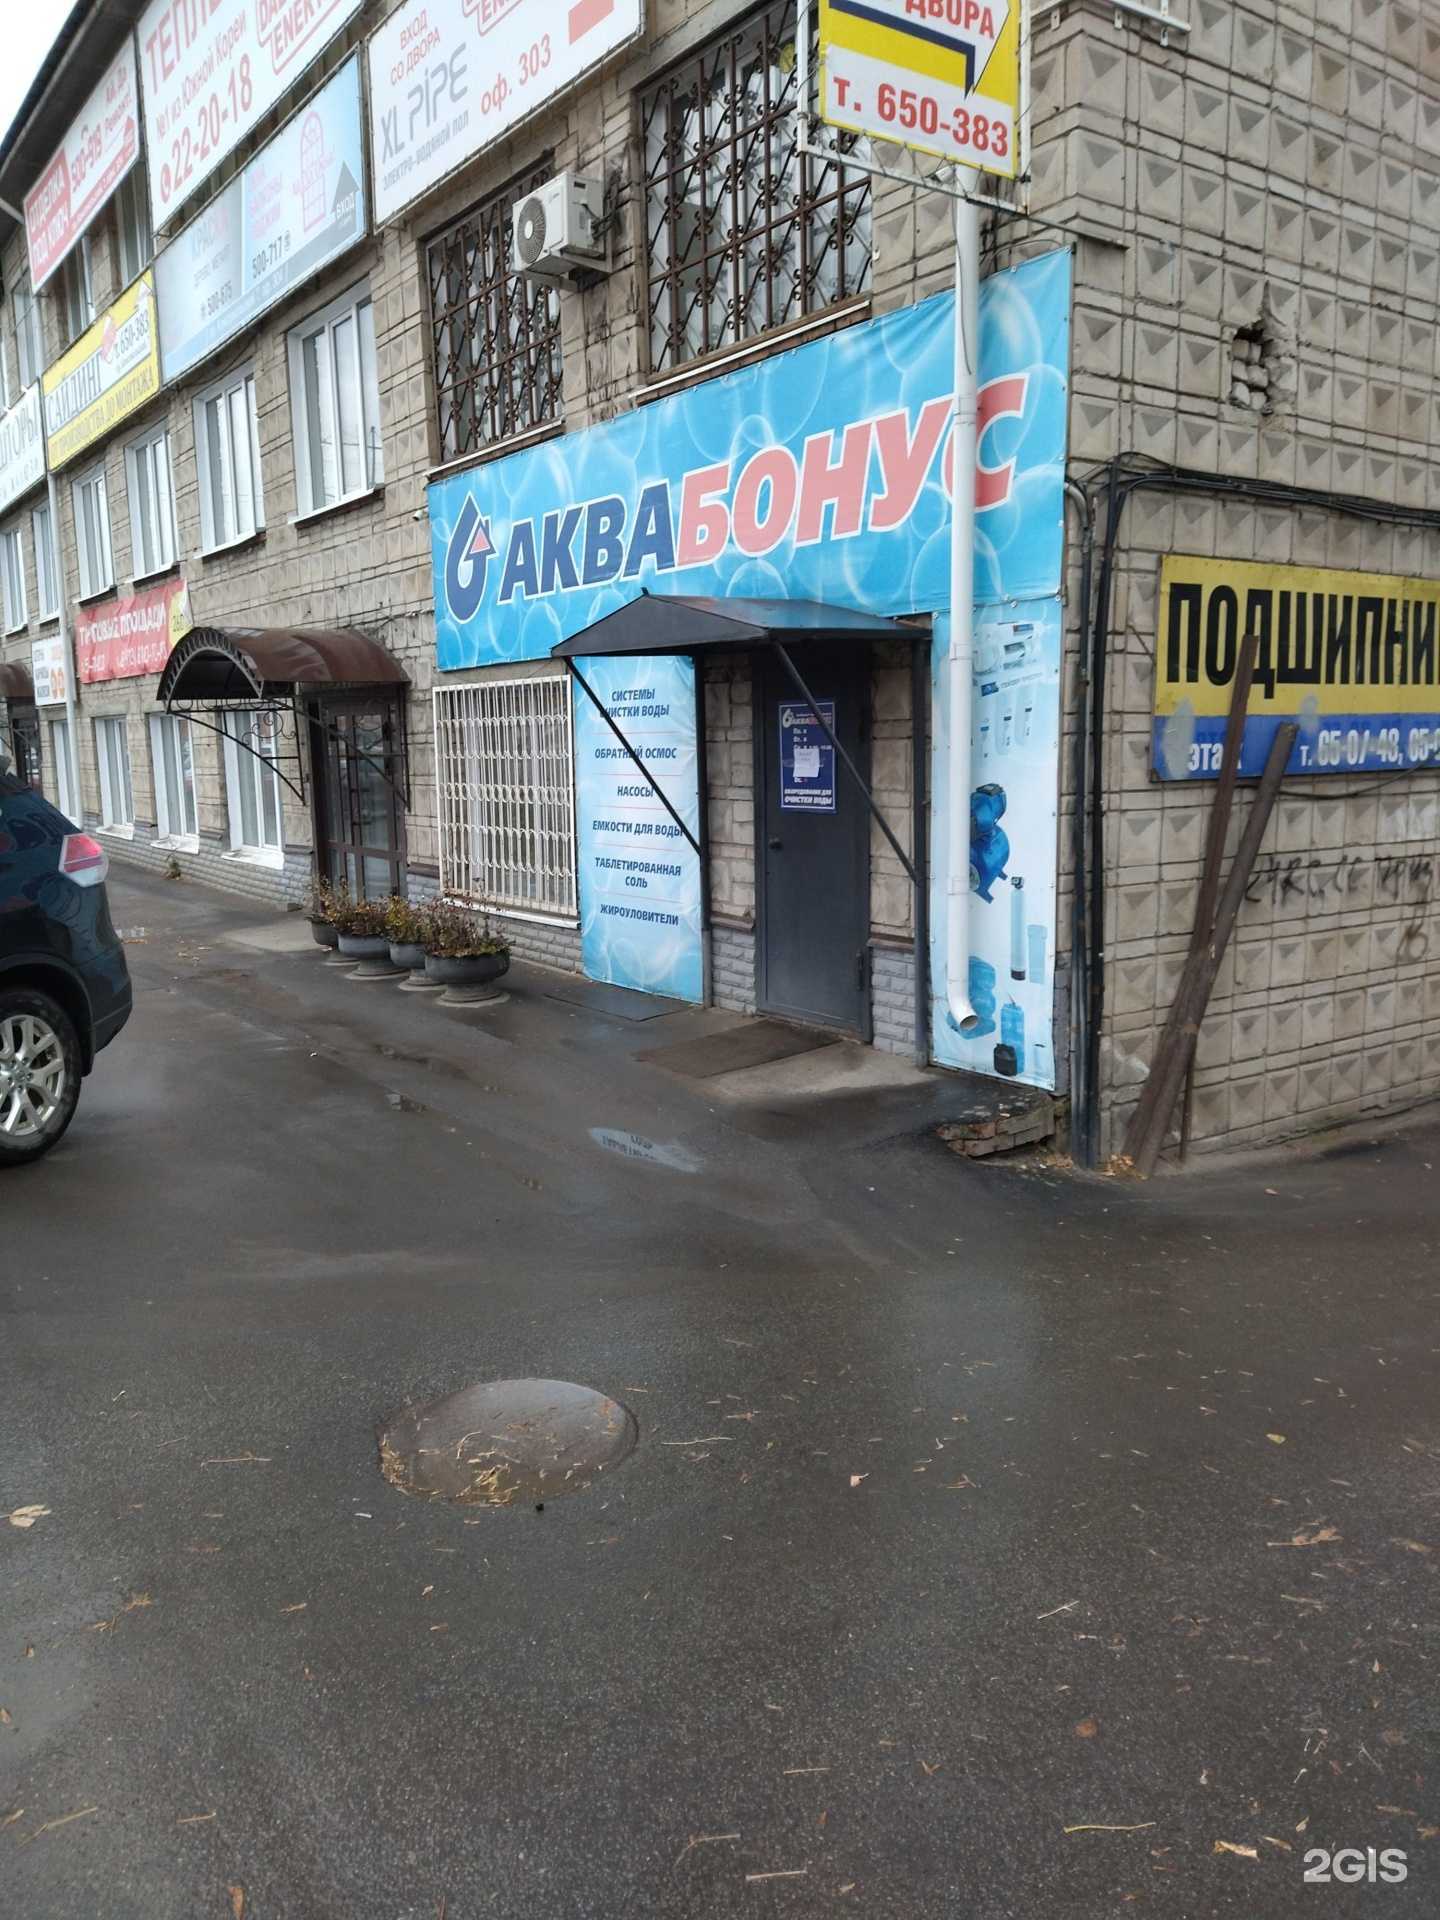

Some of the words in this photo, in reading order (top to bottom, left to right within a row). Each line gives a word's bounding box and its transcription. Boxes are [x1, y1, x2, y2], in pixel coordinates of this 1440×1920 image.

[400, 8, 428, 50] ВХОД
[146, 0, 222, 96] ТЕПЛ
[391, 61, 405, 86] СО
[406, 26, 440, 75] ДВОРА
[182, 46, 215, 109] Южной
[481, 72, 512, 115] оф.
[519, 32, 551, 86] 303
[172, 52, 252, 192] 22-20-18
[382, 105, 405, 165] XL
[453, 110, 468, 137] ПОЛ
[877, 82, 1009, 158] 650-383
[497, 374, 1029, 603] АКВАБОНУС
[1167, 583, 1440, 699] ПОДШИПНИ
[600, 706, 640, 719] ЧИСТКИ
[642, 705, 669, 718] ВОДЫ
[612, 688, 655, 702] СИСТЕМЫ
[645, 747, 677, 759] ОСМОС
[1188, 743, 1243, 771] эта
[617, 786, 654, 797] НАСОСЫ
[593, 820, 633, 833] ЕМКОСТИ
[634, 823, 653, 836] ДЛЯ
[655, 825, 683, 838] ВОДЫ
[595, 857, 681, 876] ТАБЛЕТИРОВАННАЯ
[625, 876, 648, 888] СОЛЬ
[600, 903, 679, 926] ЖИРОУЛОВИТЕЛИ
